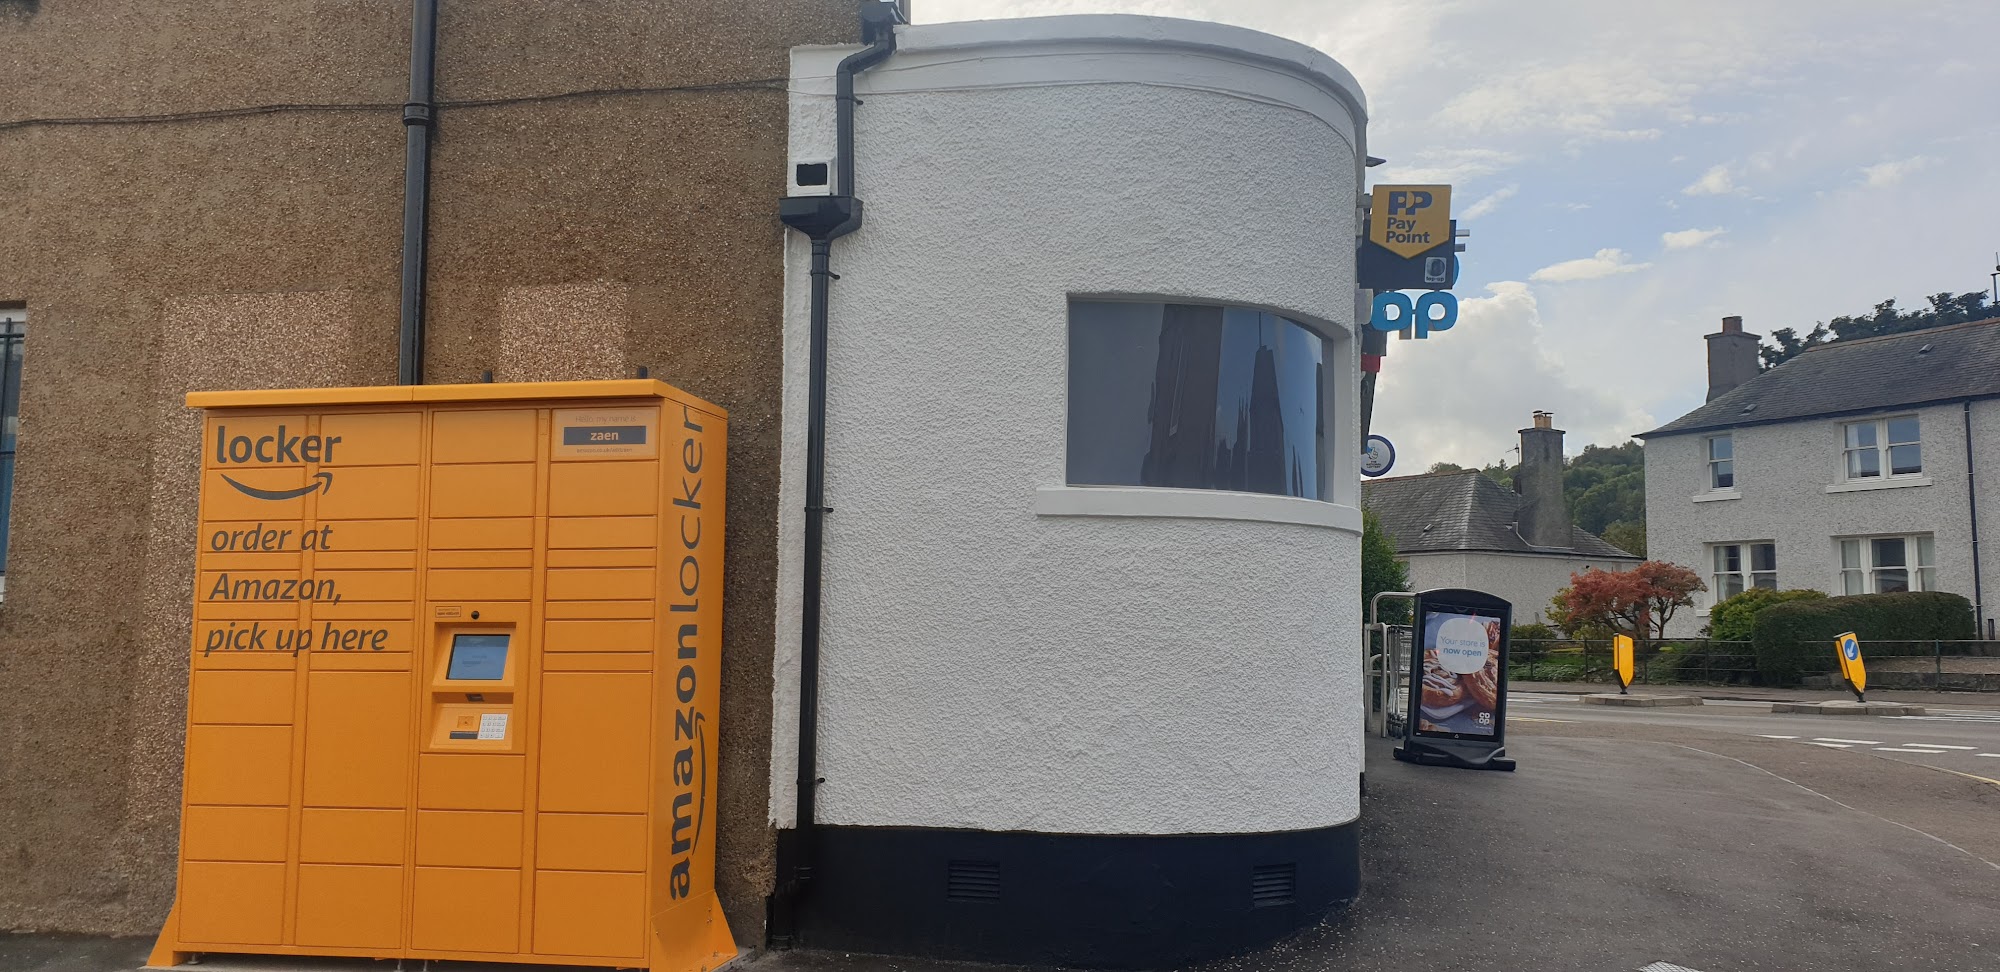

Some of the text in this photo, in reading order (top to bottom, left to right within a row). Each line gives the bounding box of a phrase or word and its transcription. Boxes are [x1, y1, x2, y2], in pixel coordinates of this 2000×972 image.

[1387, 217, 1416, 232] Pay
[1386, 231, 1430, 243] Point
[216, 425, 342, 463] locker
[590, 432, 619, 441] zaen
[211, 523, 333, 551] order at
[209, 573, 342, 606] Amazon,
[203, 622, 389, 657] pick up here
[1440, 635, 1486, 648] Your store is
[1443, 647, 1482, 658] now open
